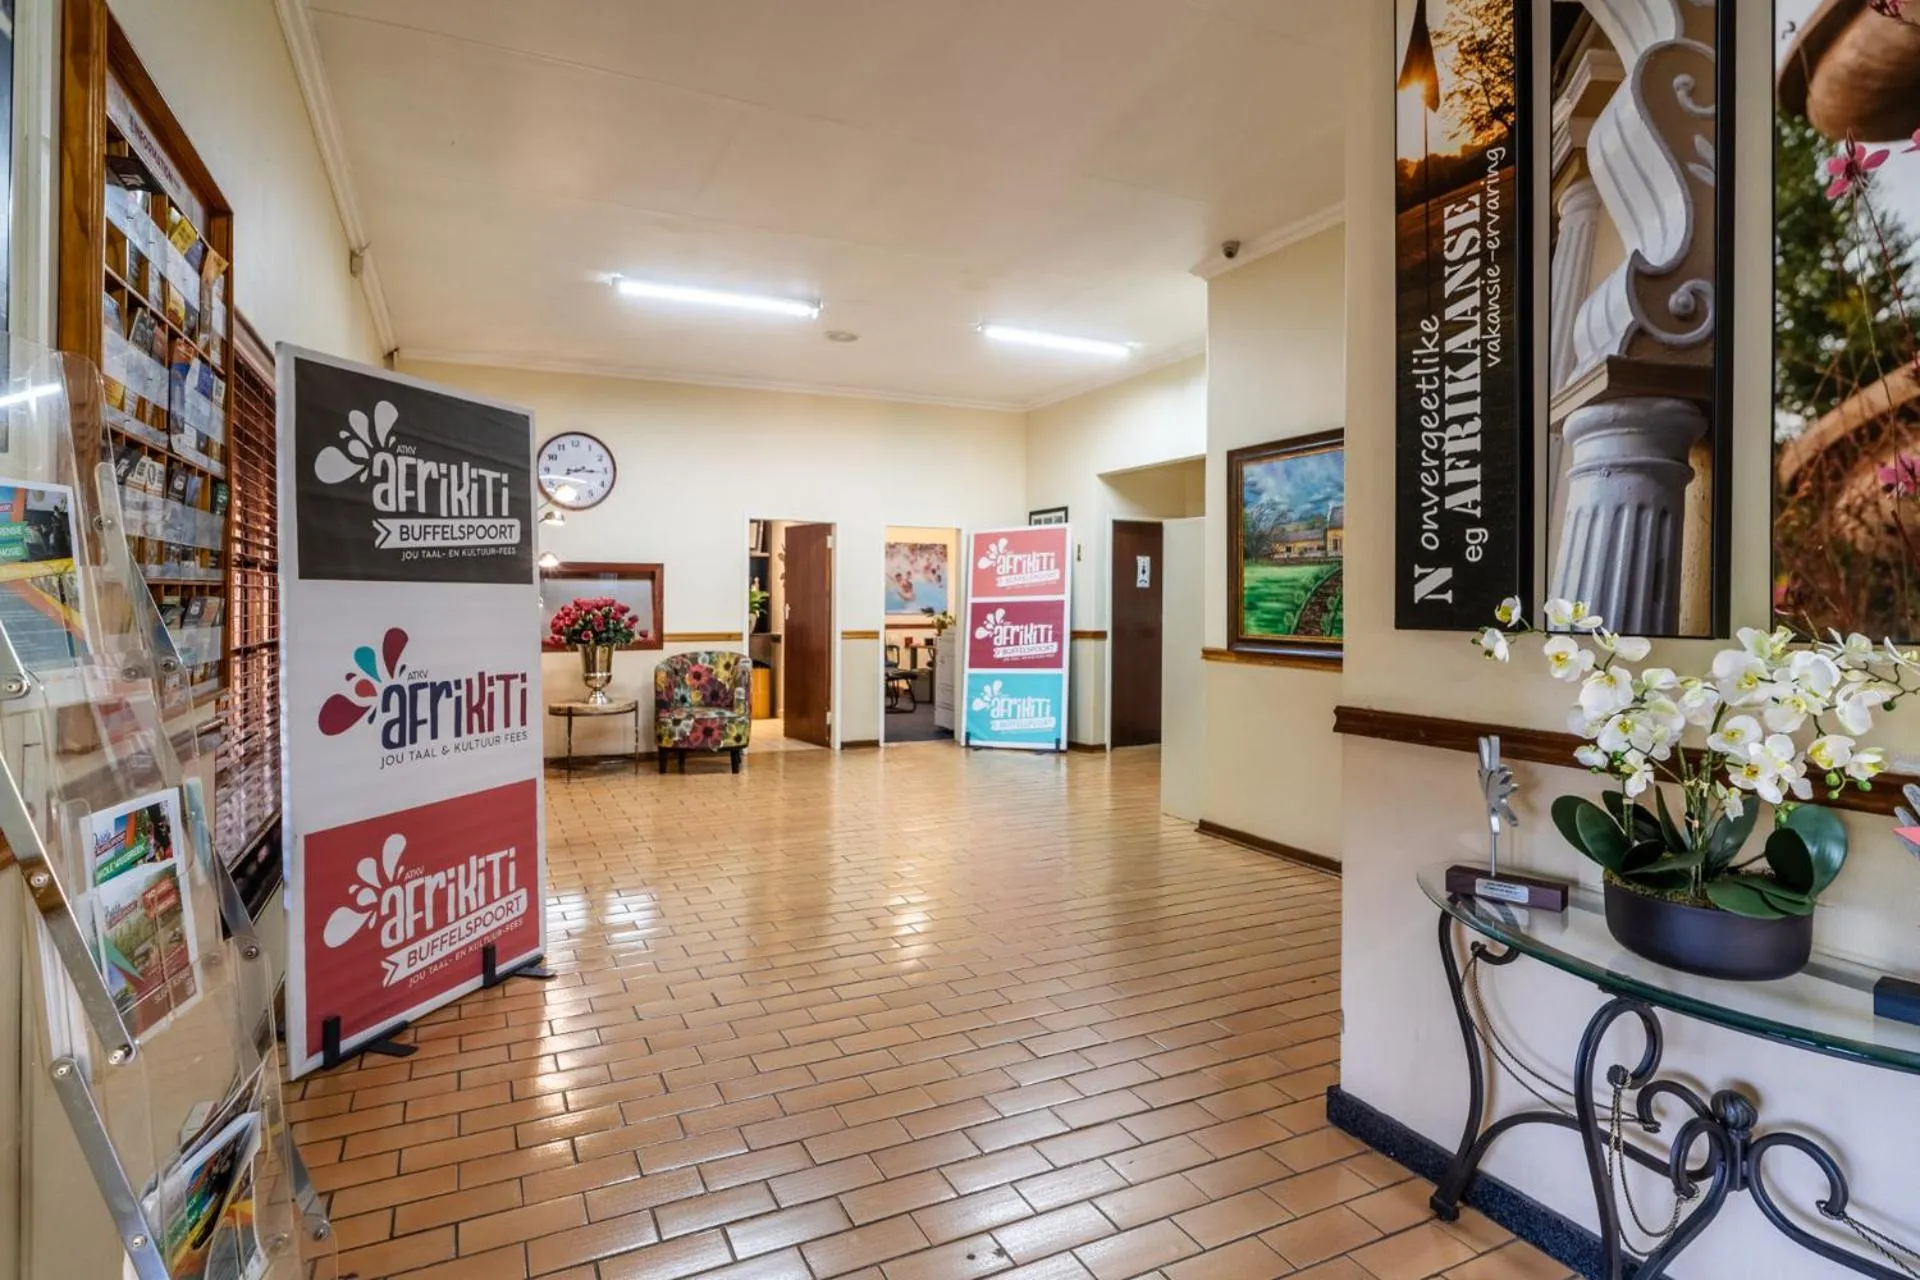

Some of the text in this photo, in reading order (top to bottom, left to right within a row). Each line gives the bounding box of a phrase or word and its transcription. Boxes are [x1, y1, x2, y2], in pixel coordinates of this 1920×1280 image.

[1480, 147, 1505, 368] vakansie-ervaring
[1444, 193, 1489, 562] eg AFRIKAANSE
[1412, 314, 1453, 604] N onvergeetlike
[399, 524, 516, 542] BUFFELSPOORT
[401, 550, 418, 562] JOU
[406, 669, 429, 681] ATKV
[380, 731, 529, 770] JOU TAAL & KULTUUR FEES
[407, 895, 522, 968] BUFFELSPOORT
[408, 971, 426, 988] JOU
